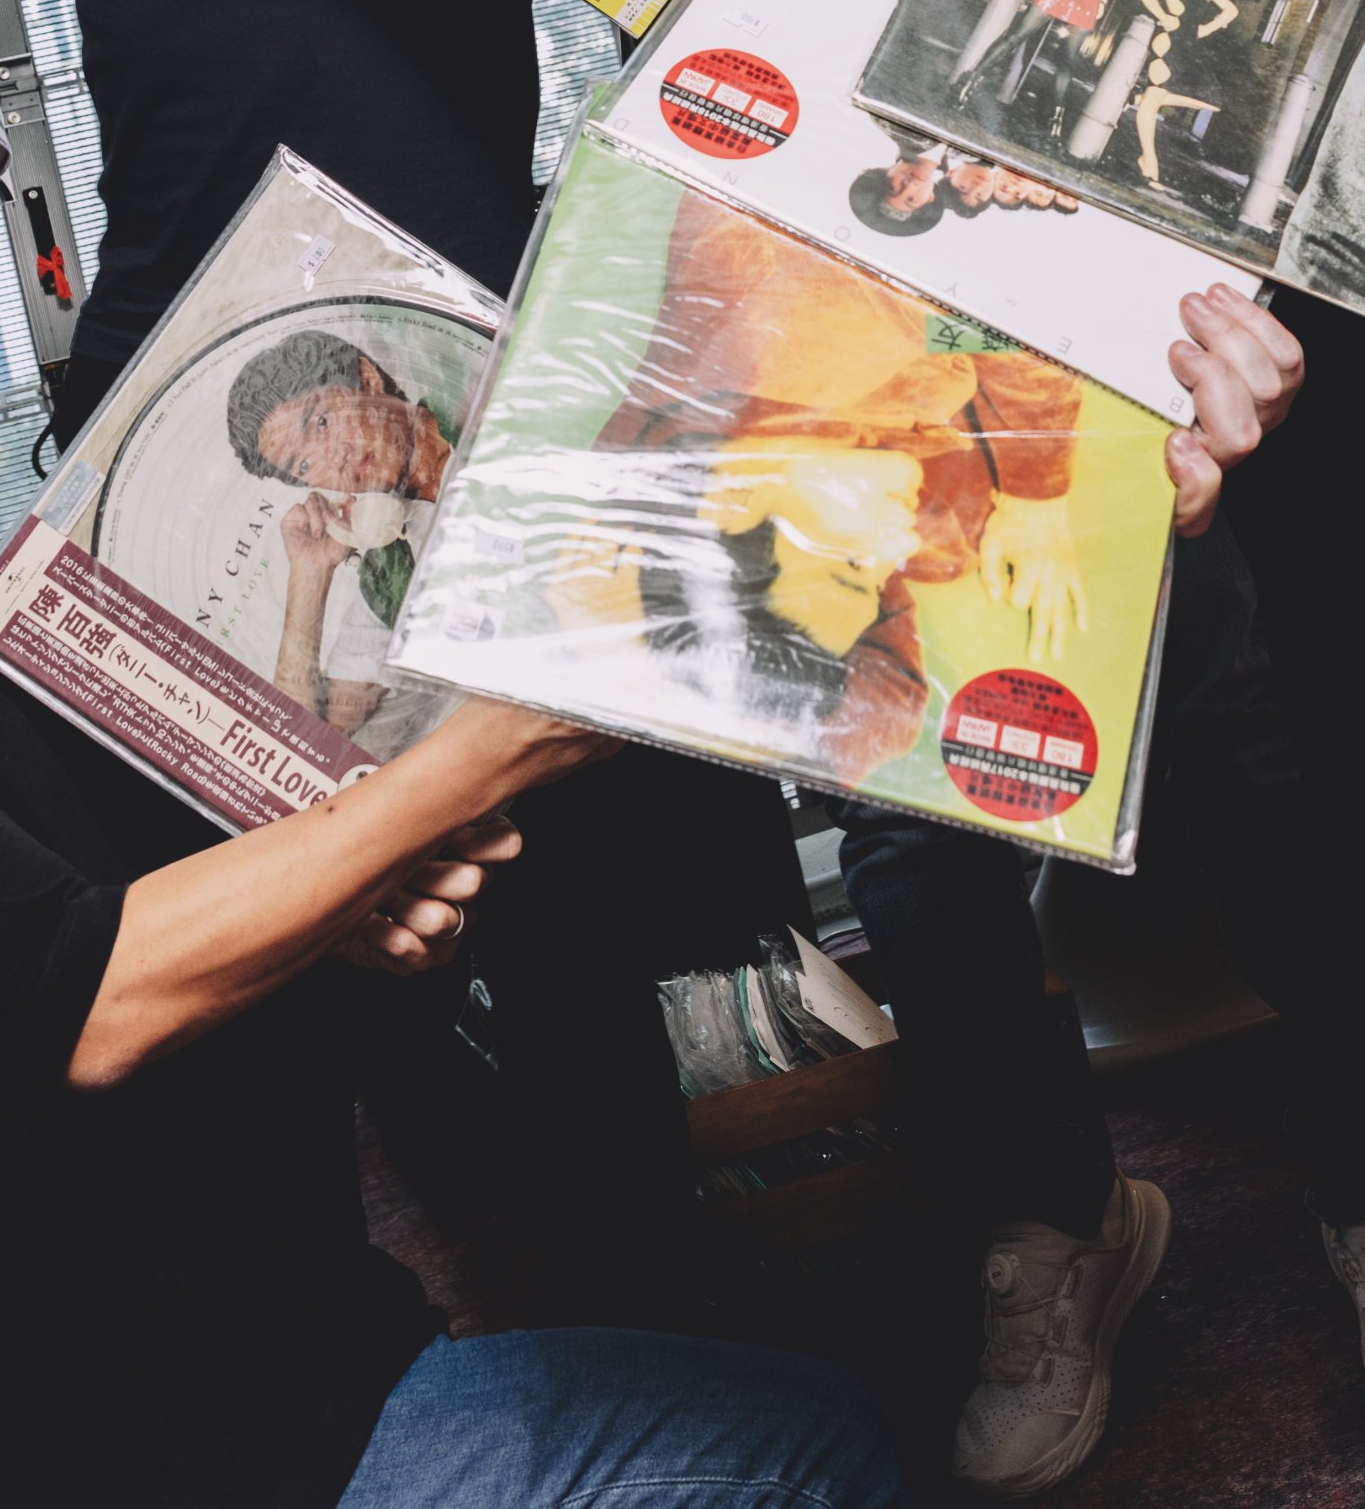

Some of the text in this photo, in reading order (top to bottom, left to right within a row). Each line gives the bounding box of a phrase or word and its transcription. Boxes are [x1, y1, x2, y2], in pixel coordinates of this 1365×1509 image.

[755, 108, 776, 124] 180
[224, 496, 277, 578] CHAN
[241, 556, 272, 599] LOVE
[220, 718, 280, 776] First
[270, 749, 329, 808] Love
